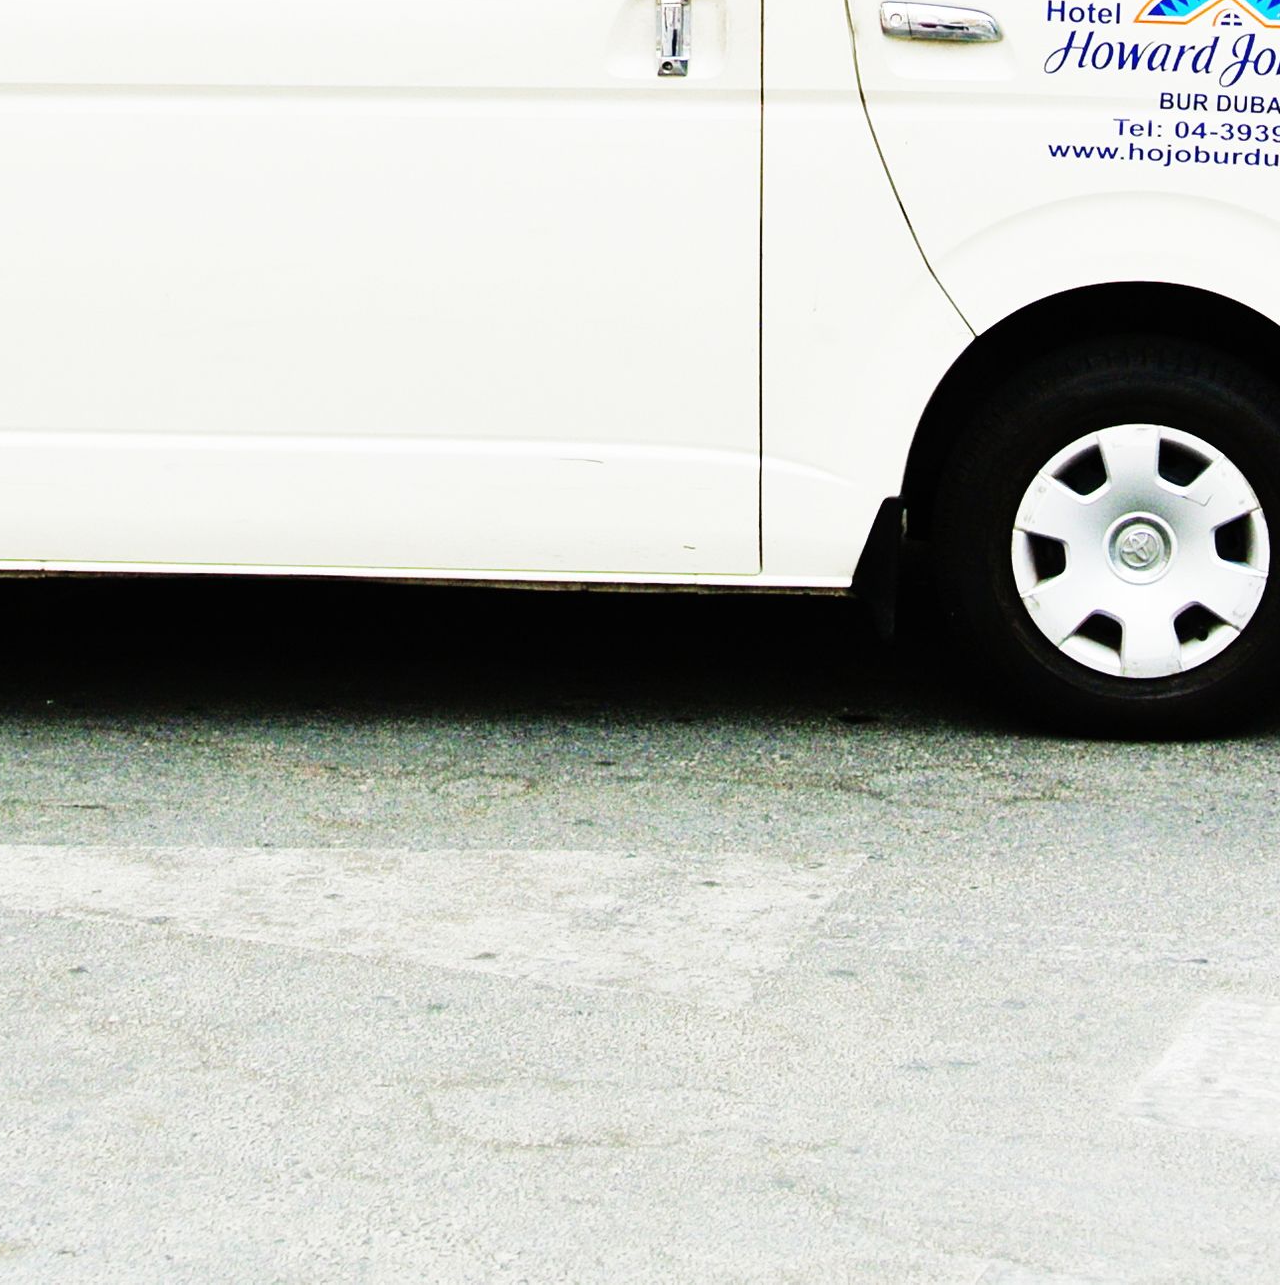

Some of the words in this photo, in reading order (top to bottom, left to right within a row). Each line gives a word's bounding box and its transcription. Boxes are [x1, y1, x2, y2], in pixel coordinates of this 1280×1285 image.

[1046, 0, 1121, 25] Hotel
[1043, 30, 1221, 75] Howard
[1159, 92, 1209, 112] BUR
[1113, 118, 1163, 138] Tel:
